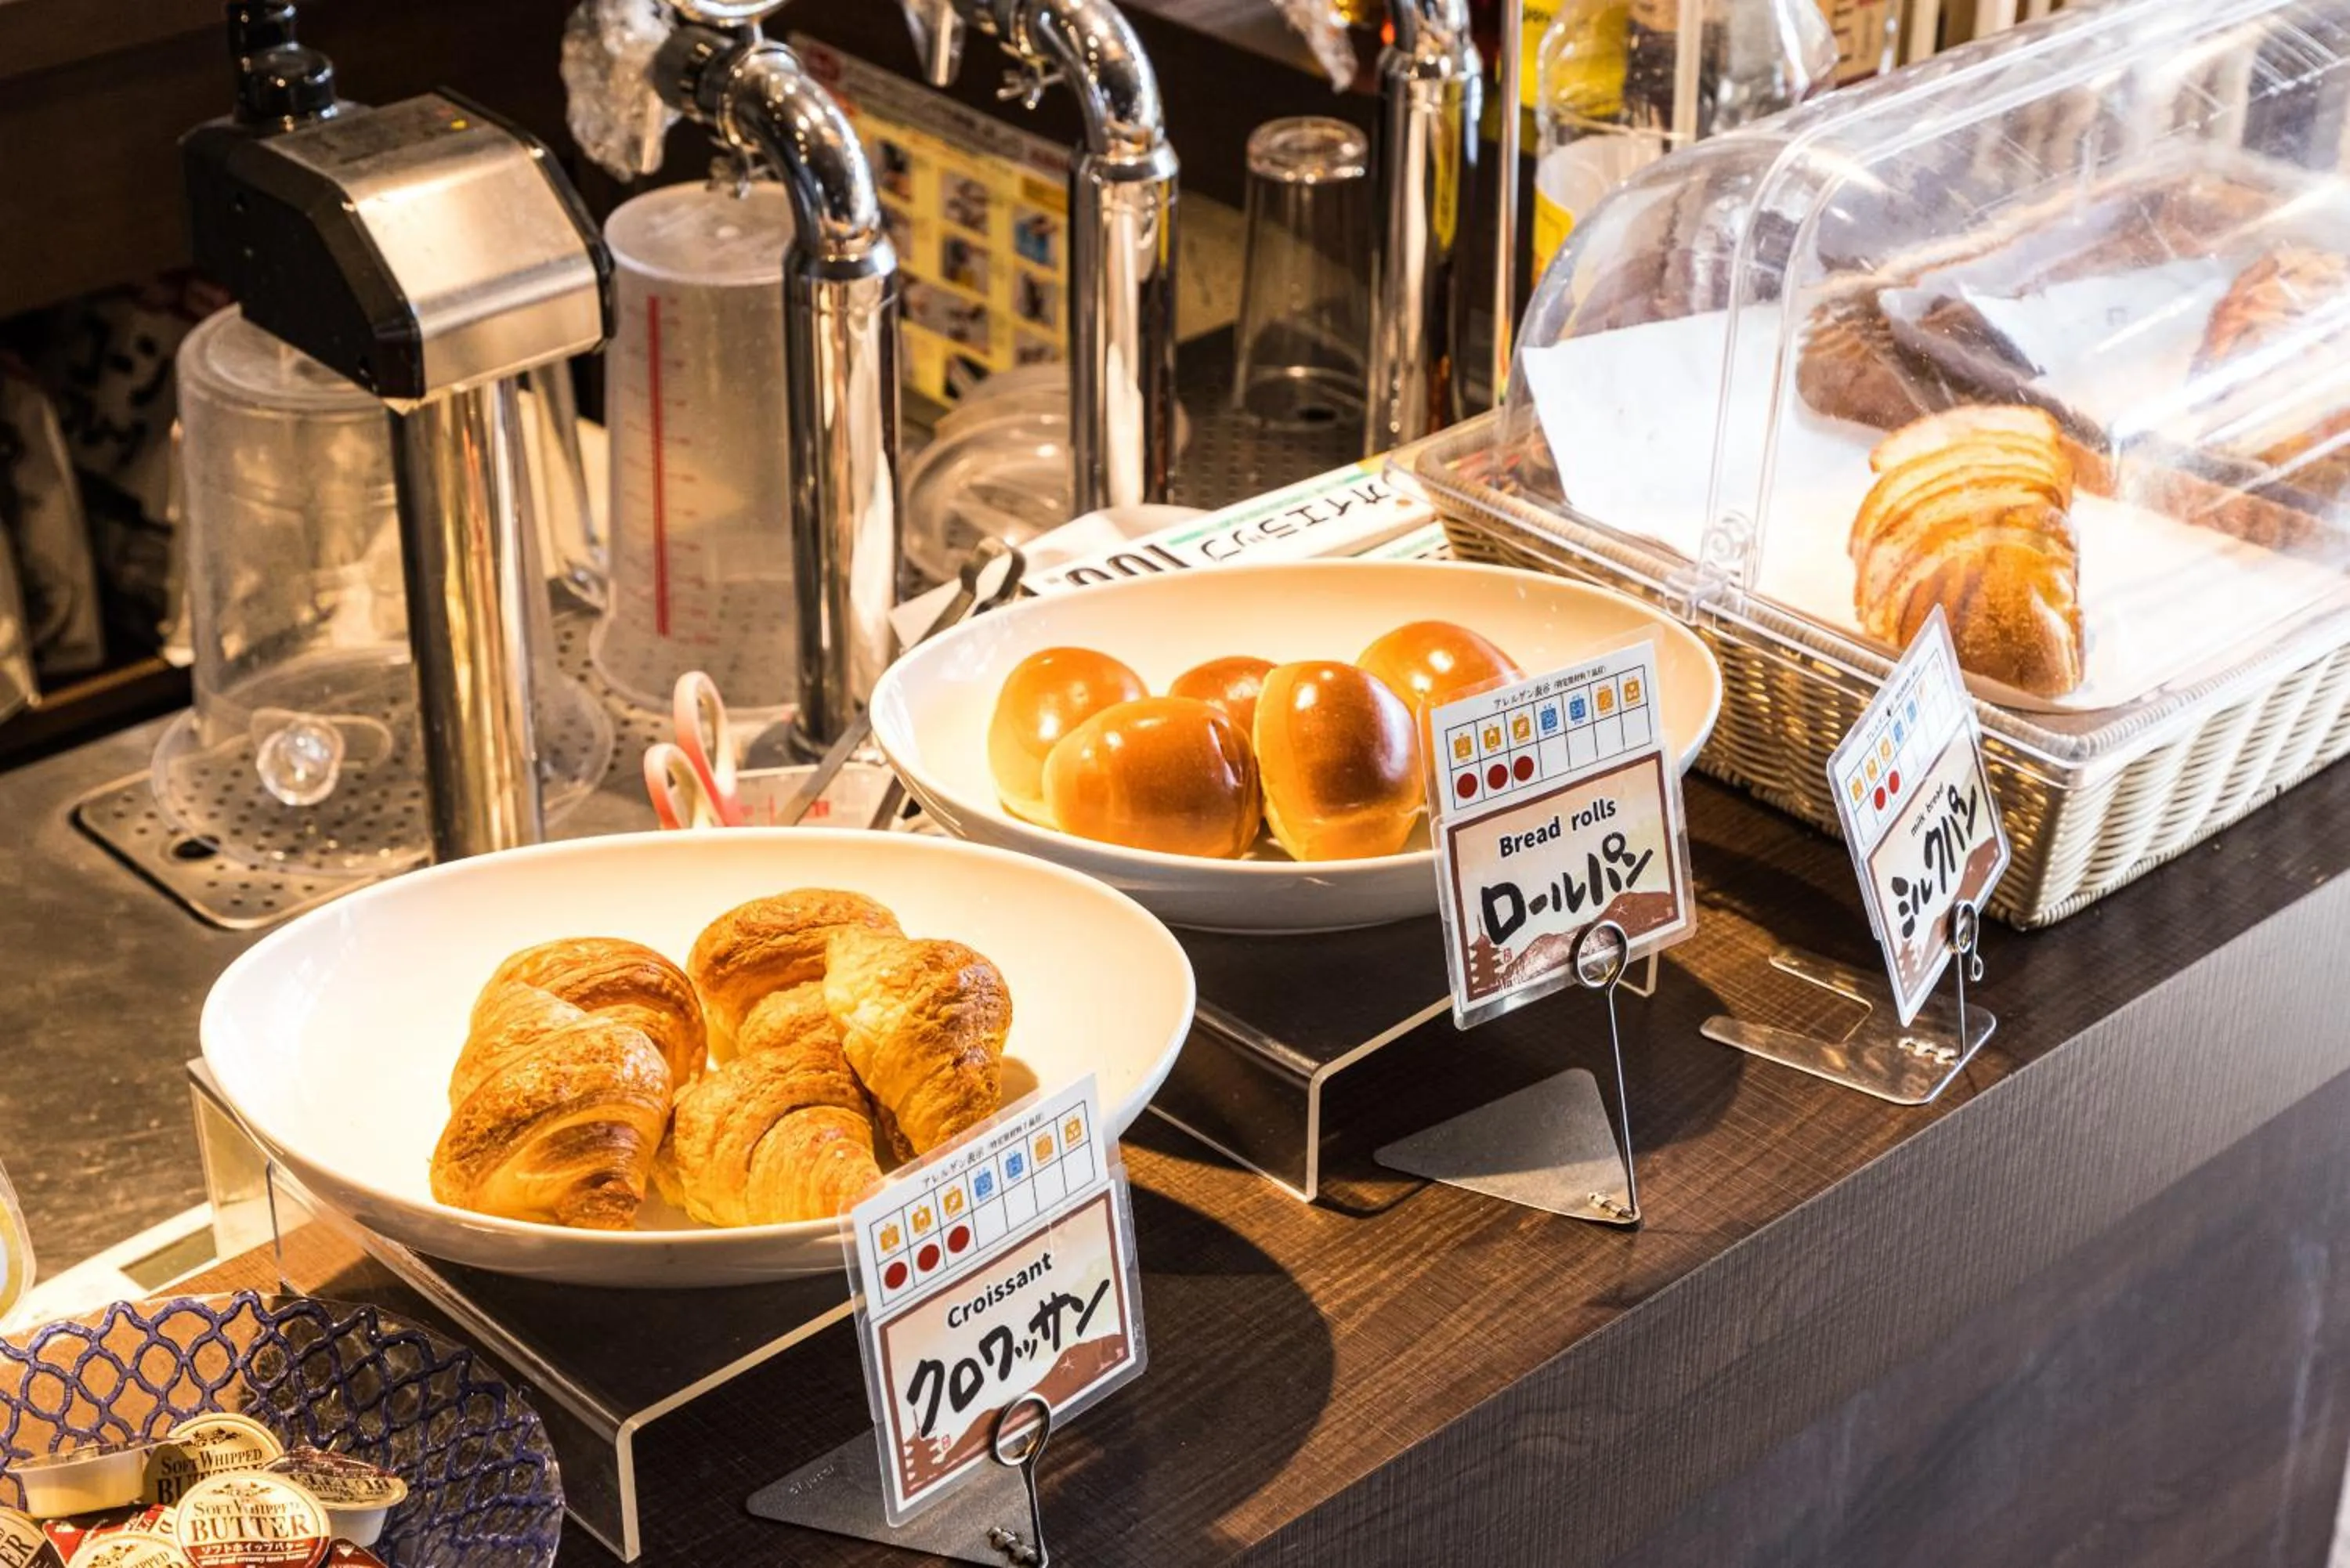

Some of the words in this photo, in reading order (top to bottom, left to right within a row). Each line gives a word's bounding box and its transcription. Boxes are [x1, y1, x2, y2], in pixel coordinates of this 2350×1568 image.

[1499, 815, 1561, 858] Bread
[1571, 798, 1616, 831] rolls
[1481, 832, 1654, 945] ロールパン
[1891, 784, 1977, 938] ミルクパン
[947, 1252, 1053, 1328] Croissant
[906, 1278, 1111, 1438] クロワッサン
[198, 1448, 263, 1469] WHIPPED
[190, 1515, 310, 1542] BUTTER
[193, 1501, 233, 1517] SOFT
[201, 1542, 306, 1555] ソフトホイップバター
